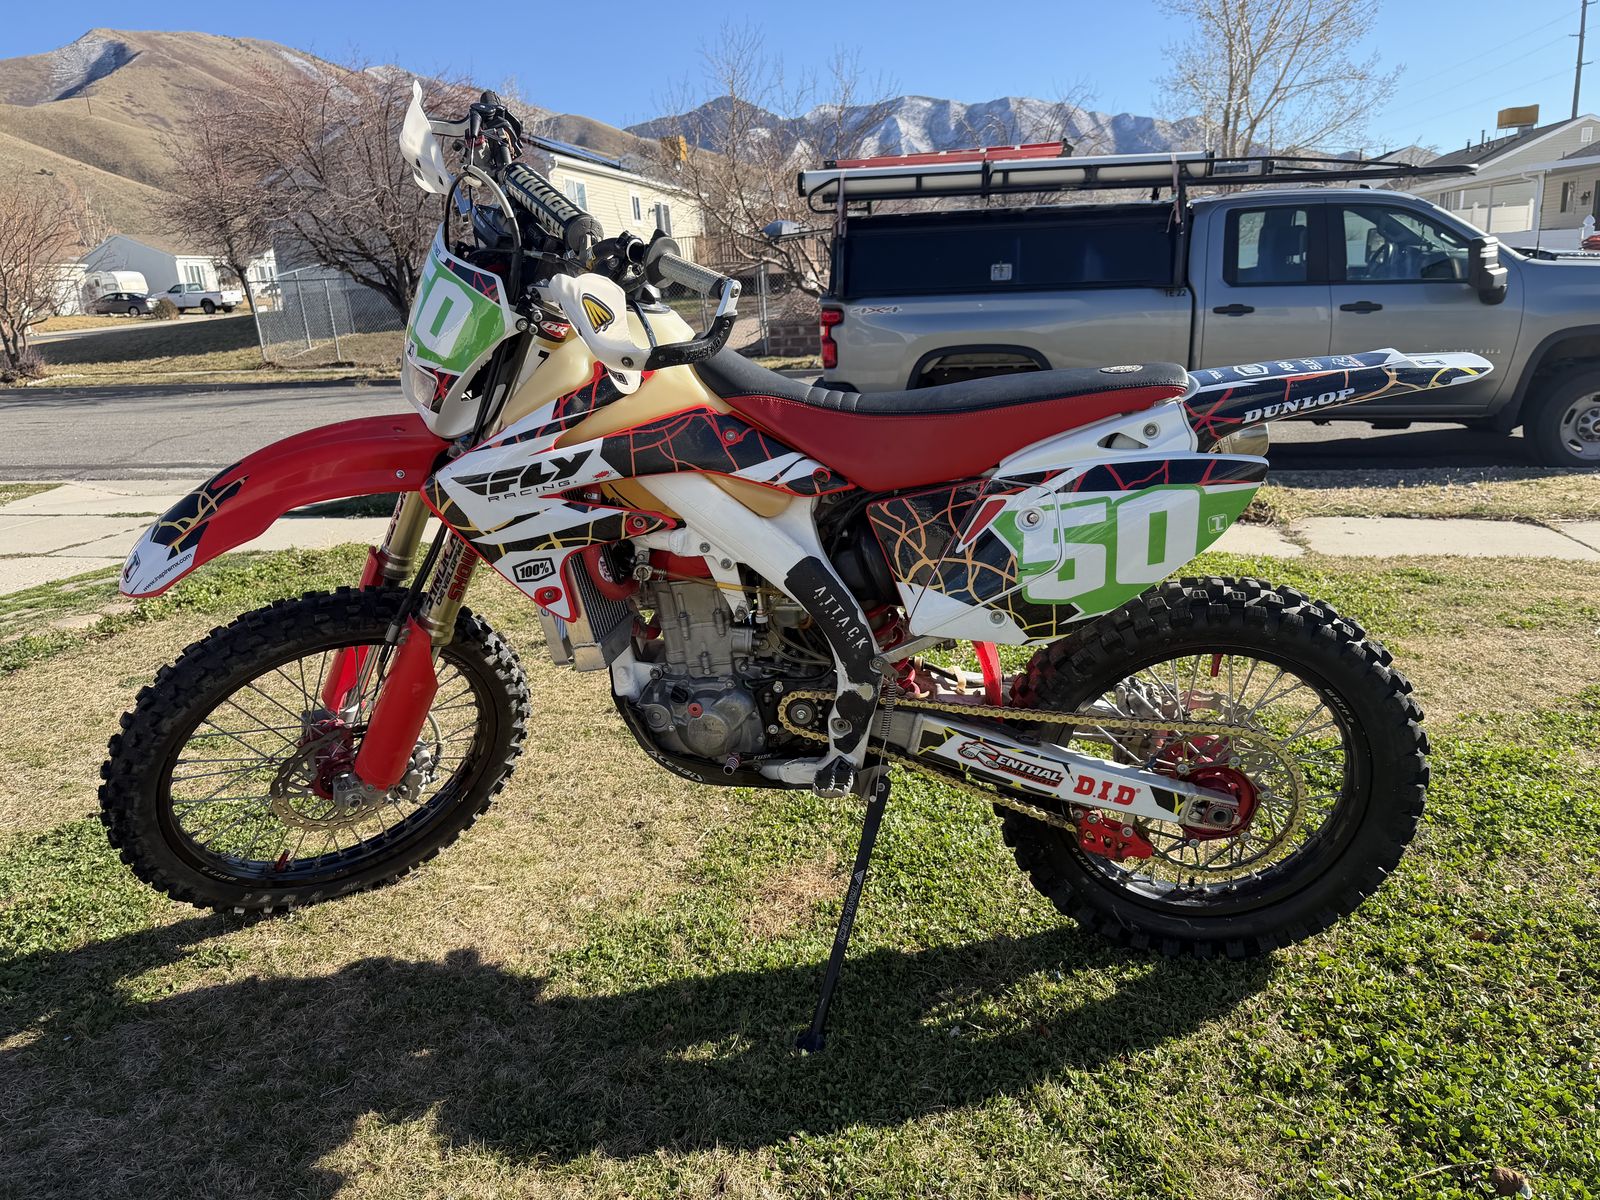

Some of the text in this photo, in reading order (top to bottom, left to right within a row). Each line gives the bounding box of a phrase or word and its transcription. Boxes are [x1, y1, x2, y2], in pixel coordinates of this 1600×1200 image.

[509, 164, 580, 221] RENTHAL
[1242, 387, 1356, 424] DUNLOP
[451, 449, 594, 496] FLY
[487, 480, 572, 503] RACING
[1021, 489, 1200, 600] 50
[143, 553, 193, 592] www.inspiremx.com
[519, 561, 550, 579] 100%
[814, 586, 869, 650] ATTACK
